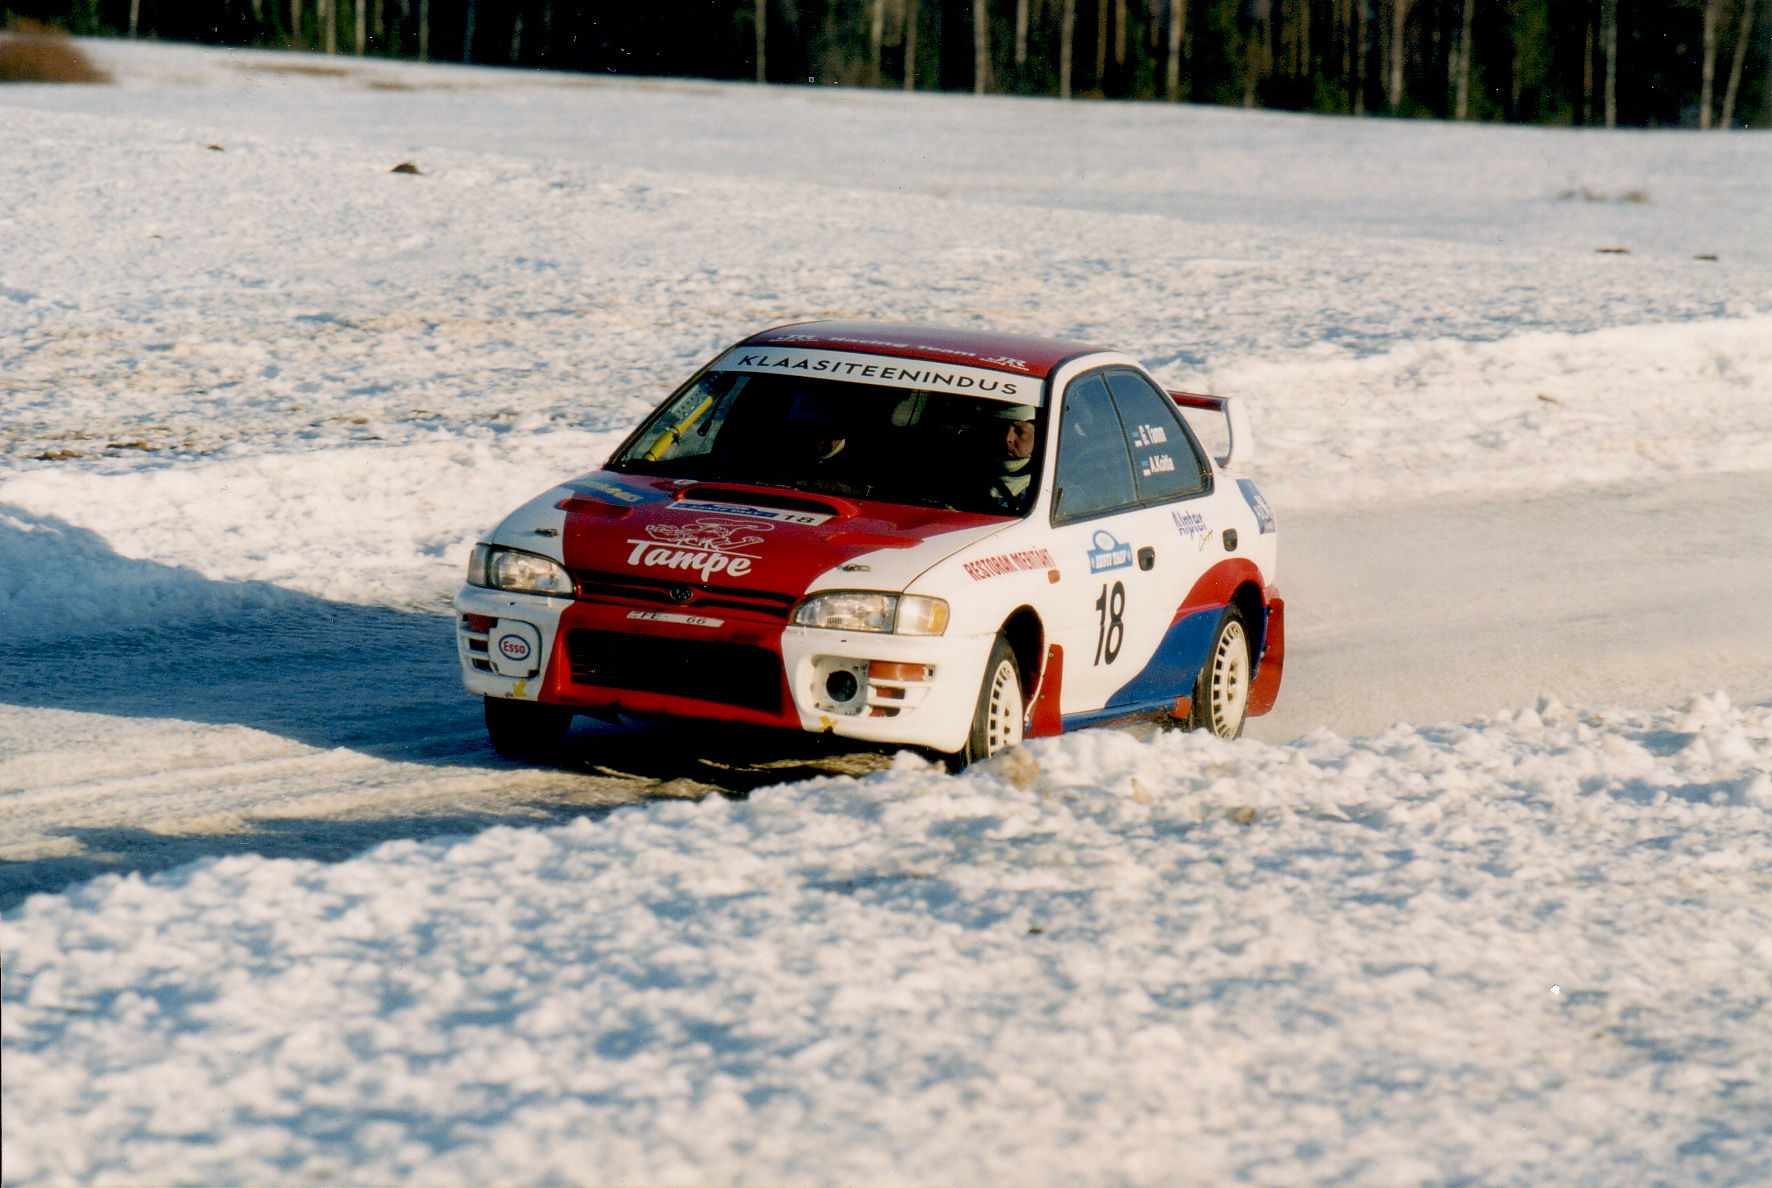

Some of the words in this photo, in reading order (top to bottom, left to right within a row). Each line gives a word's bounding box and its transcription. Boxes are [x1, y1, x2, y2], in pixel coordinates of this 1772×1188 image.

[738, 354, 1017, 395] KLAASITEENINDUS
[784, 514, 815, 523] 18
[626, 540, 753, 582] Tampe
[962, 553, 1018, 582] RESTORAN
[1093, 580, 1126, 667] 18
